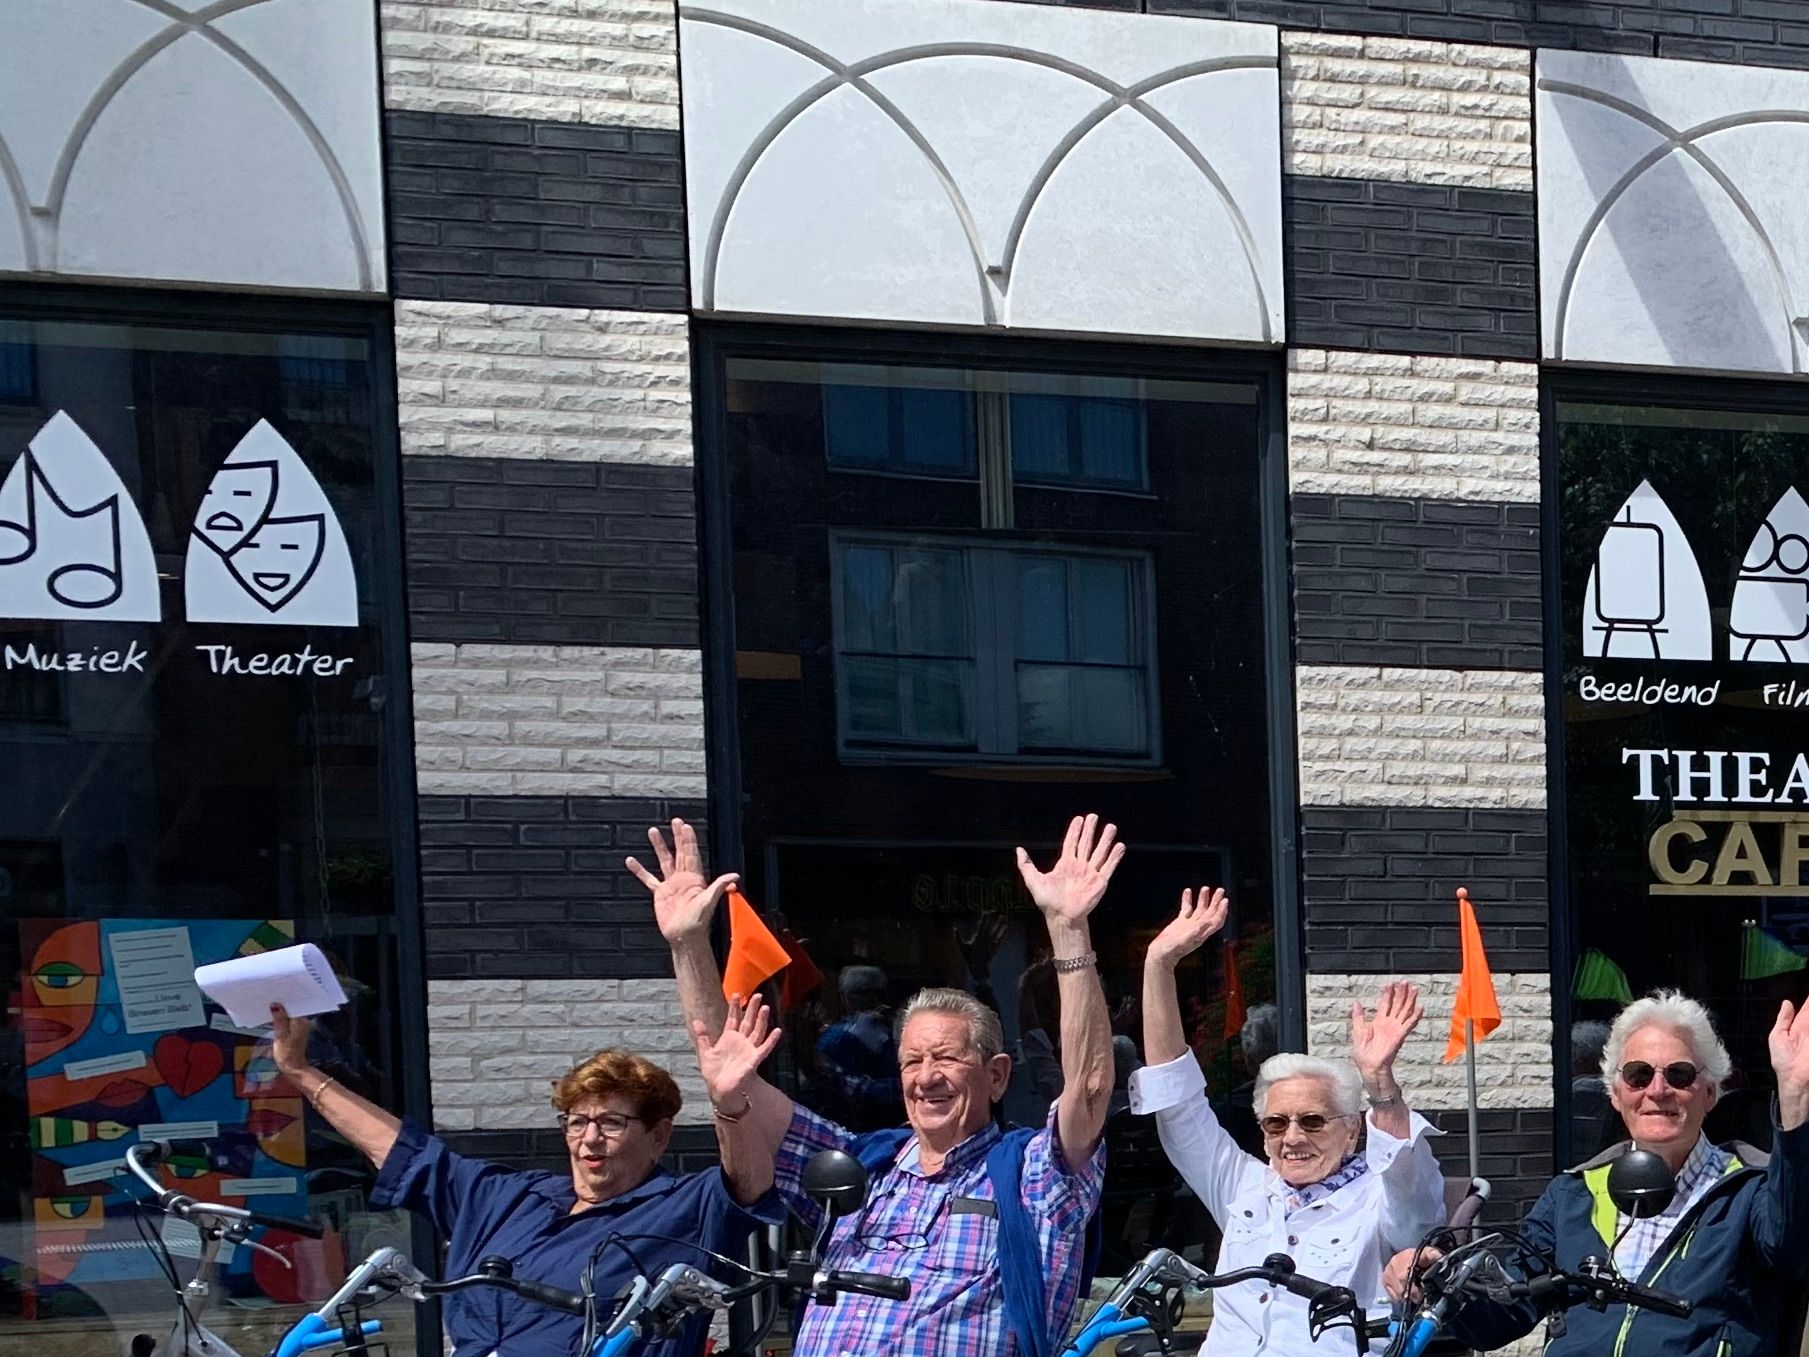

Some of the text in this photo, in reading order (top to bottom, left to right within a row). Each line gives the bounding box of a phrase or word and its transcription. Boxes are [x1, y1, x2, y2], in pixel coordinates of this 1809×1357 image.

[5, 640, 148, 673] Muziek
[195, 644, 354, 677] Theater
[1579, 675, 1721, 706] Beeldend
